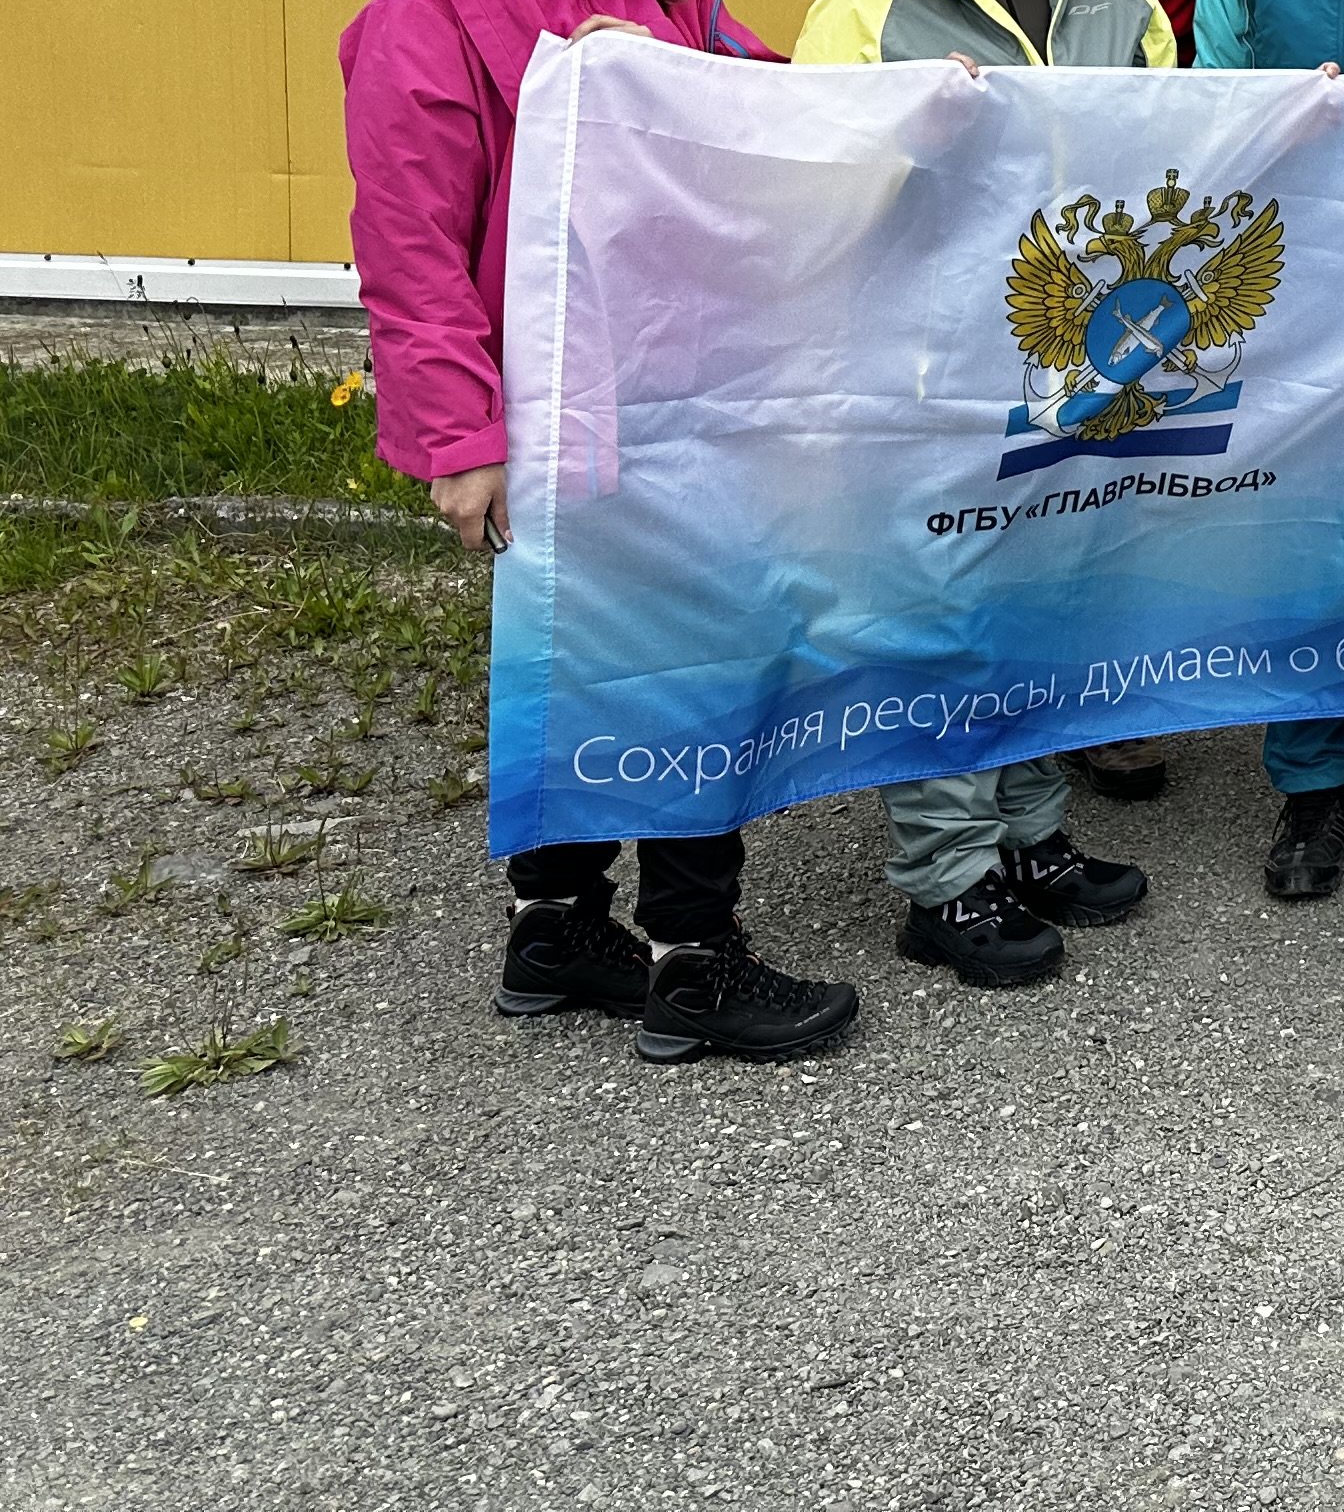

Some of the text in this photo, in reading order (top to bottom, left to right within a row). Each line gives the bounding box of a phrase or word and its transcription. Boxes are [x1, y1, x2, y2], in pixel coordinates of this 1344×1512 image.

[926, 468, 1278, 535] ФГБУ «ГЛАВРЫБВОД»
[573, 705, 823, 795] Сохраняя
[840, 674, 1067, 741] ресурсы,
[1078, 645, 1272, 703] думаем
[1289, 645, 1320, 675] о
